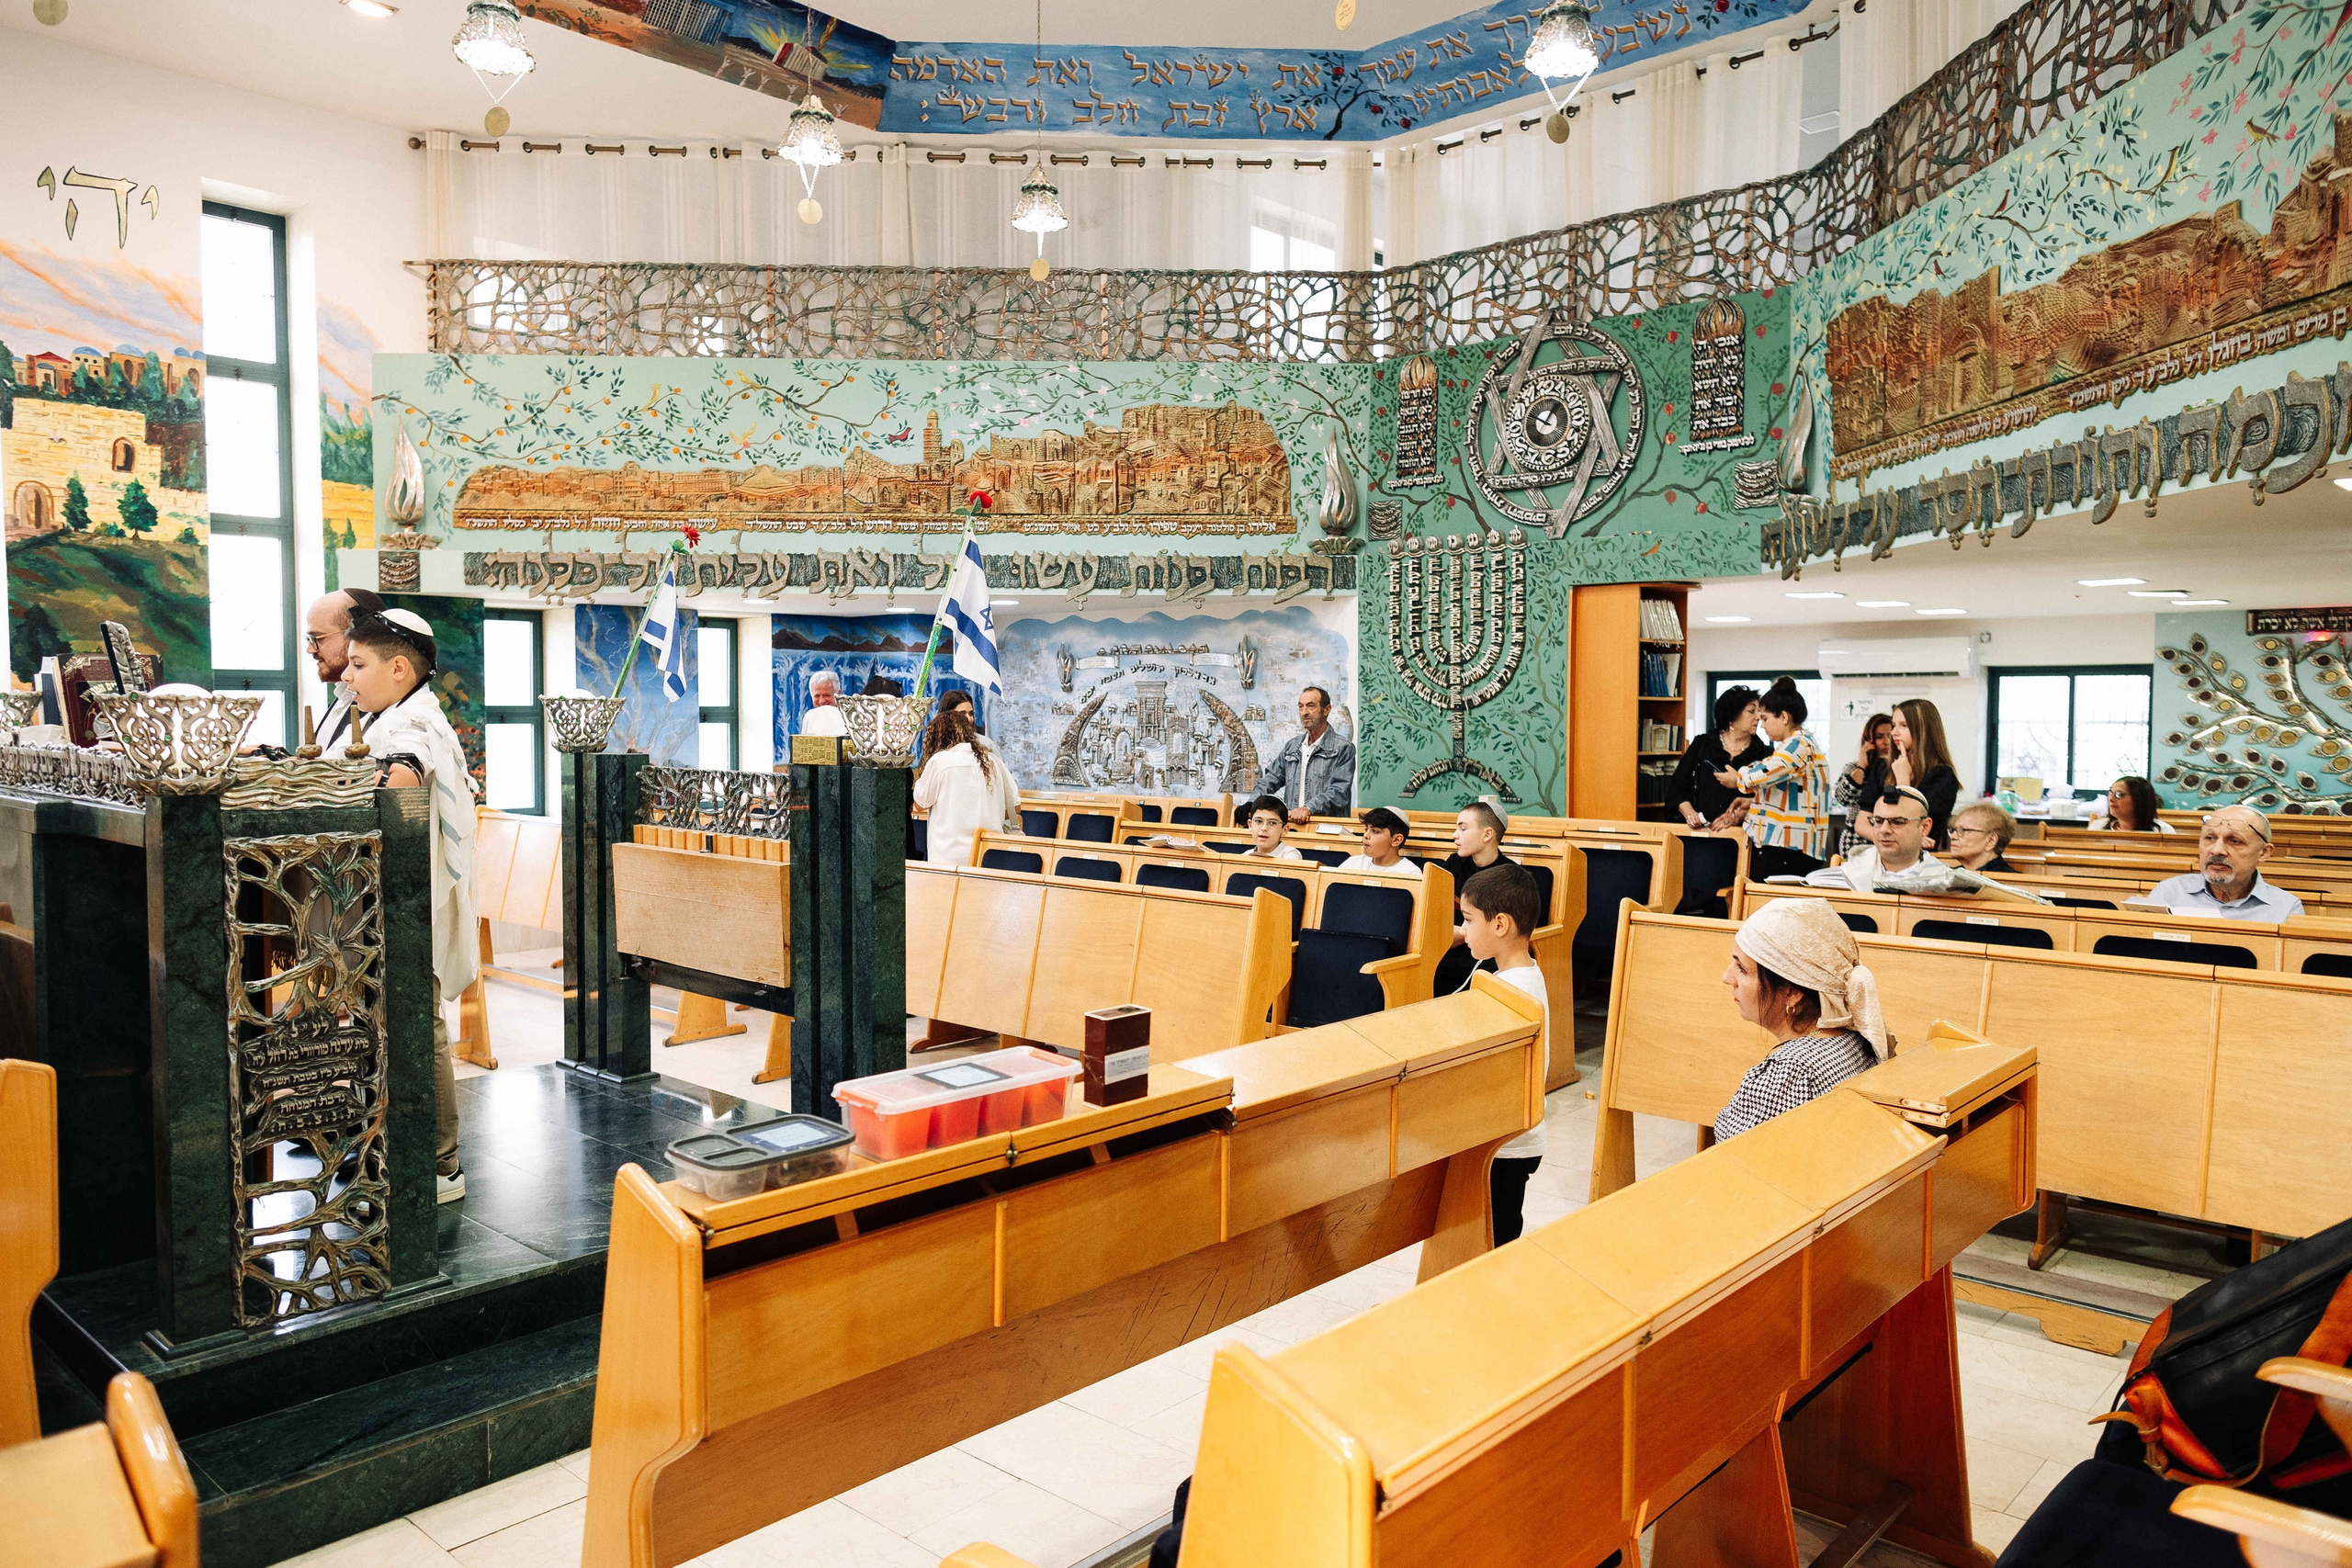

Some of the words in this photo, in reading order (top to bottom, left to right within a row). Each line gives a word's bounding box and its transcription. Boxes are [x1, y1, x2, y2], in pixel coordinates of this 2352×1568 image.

[1589, 0, 1692, 65] נשבע
[1424, 28, 1473, 69] את
[889, 53, 1007, 85] האדמה
[1027, 56, 1093, 86] ואת
[1124, 49, 1250, 89] ישראל
[1272, 61, 1321, 91] את
[1358, 45, 1417, 90] עמך
[1072, 85, 1139, 125] חלב
[1161, 95, 1230, 133] זבת
[1249, 88, 1318, 137] ארץ
[2295, 312, 2328, 337] מרים
[1714, 334, 1739, 347] אנכי
[2256, 324, 2290, 350] ומשה
[1498, 339, 1521, 360] לכל
[2208, 331, 2252, 364] בוזגלו
[1694, 358, 1716, 370] יהיה
[1723, 353, 1738, 367] לא
[1536, 380, 1559, 396] 12
[1694, 378, 1720, 390] תשא
[1722, 371, 1738, 386] לא
[2111, 375, 2130, 400] ניסן
[1695, 398, 1712, 410] את
[1714, 395, 1737, 407] זכור
[1692, 418, 1711, 430] את
[1713, 415, 1737, 428] כבד
[1541, 449, 1555, 466] 6
[786, 520, 807, 530] שבט
[865, 519, 893, 532] הרוש
[896, 522, 920, 532] ומשה
[1181, 524, 1203, 536] ויעקב
[1237, 524, 1246, 534] בן
[1248, 515, 1277, 533] אליהו
[1402, 558, 1422, 583] לדעת
[1490, 553, 1509, 571] ארץ
[1511, 551, 1524, 581] יברכנו
[1385, 560, 1400, 592] אלהים
[1408, 587, 1426, 611] בארץ
[1423, 592, 1442, 614] אלהים
[1507, 583, 1525, 614] אלהים
[2256, 617, 2282, 631] יכרת
[2285, 610, 2299, 630] לא
[2301, 616, 2325, 630] אשר
